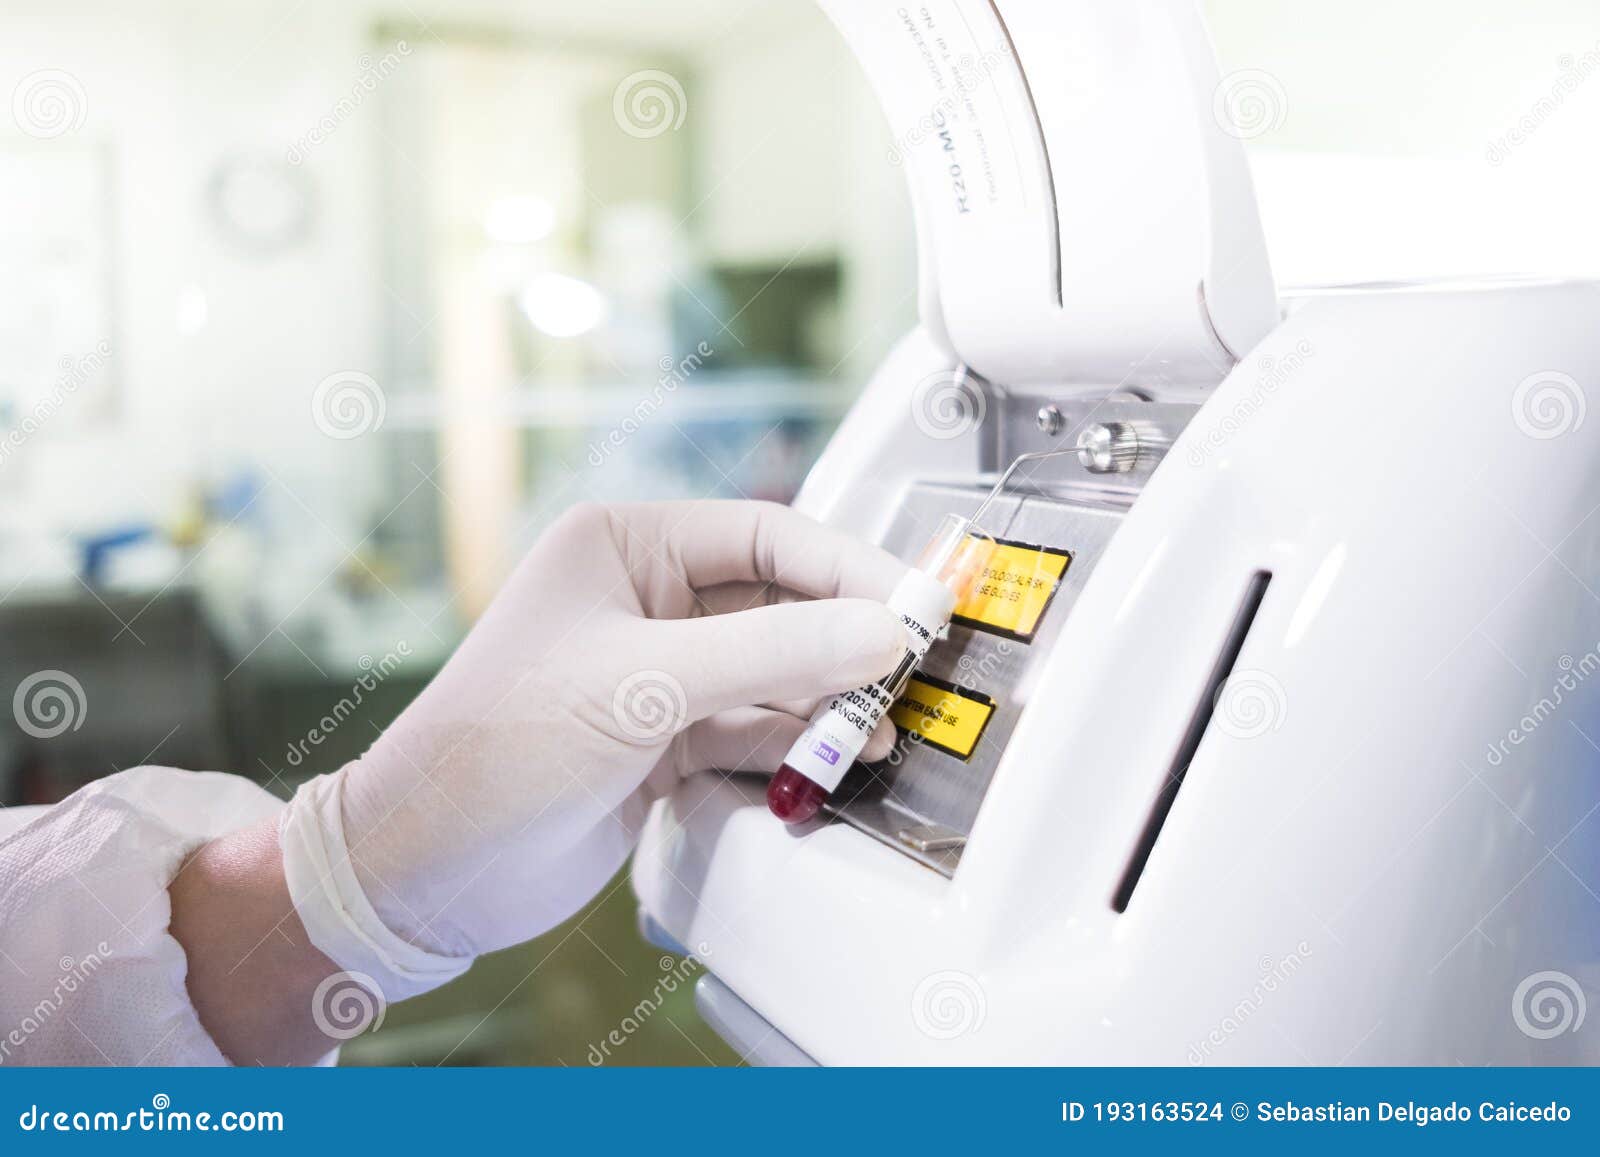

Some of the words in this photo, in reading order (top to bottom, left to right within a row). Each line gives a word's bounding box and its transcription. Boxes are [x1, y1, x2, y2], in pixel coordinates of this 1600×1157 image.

[932, 109, 971, 214] R20-MC
[830, 700, 868, 730] SANGRE
[943, 713, 959, 727] USE
